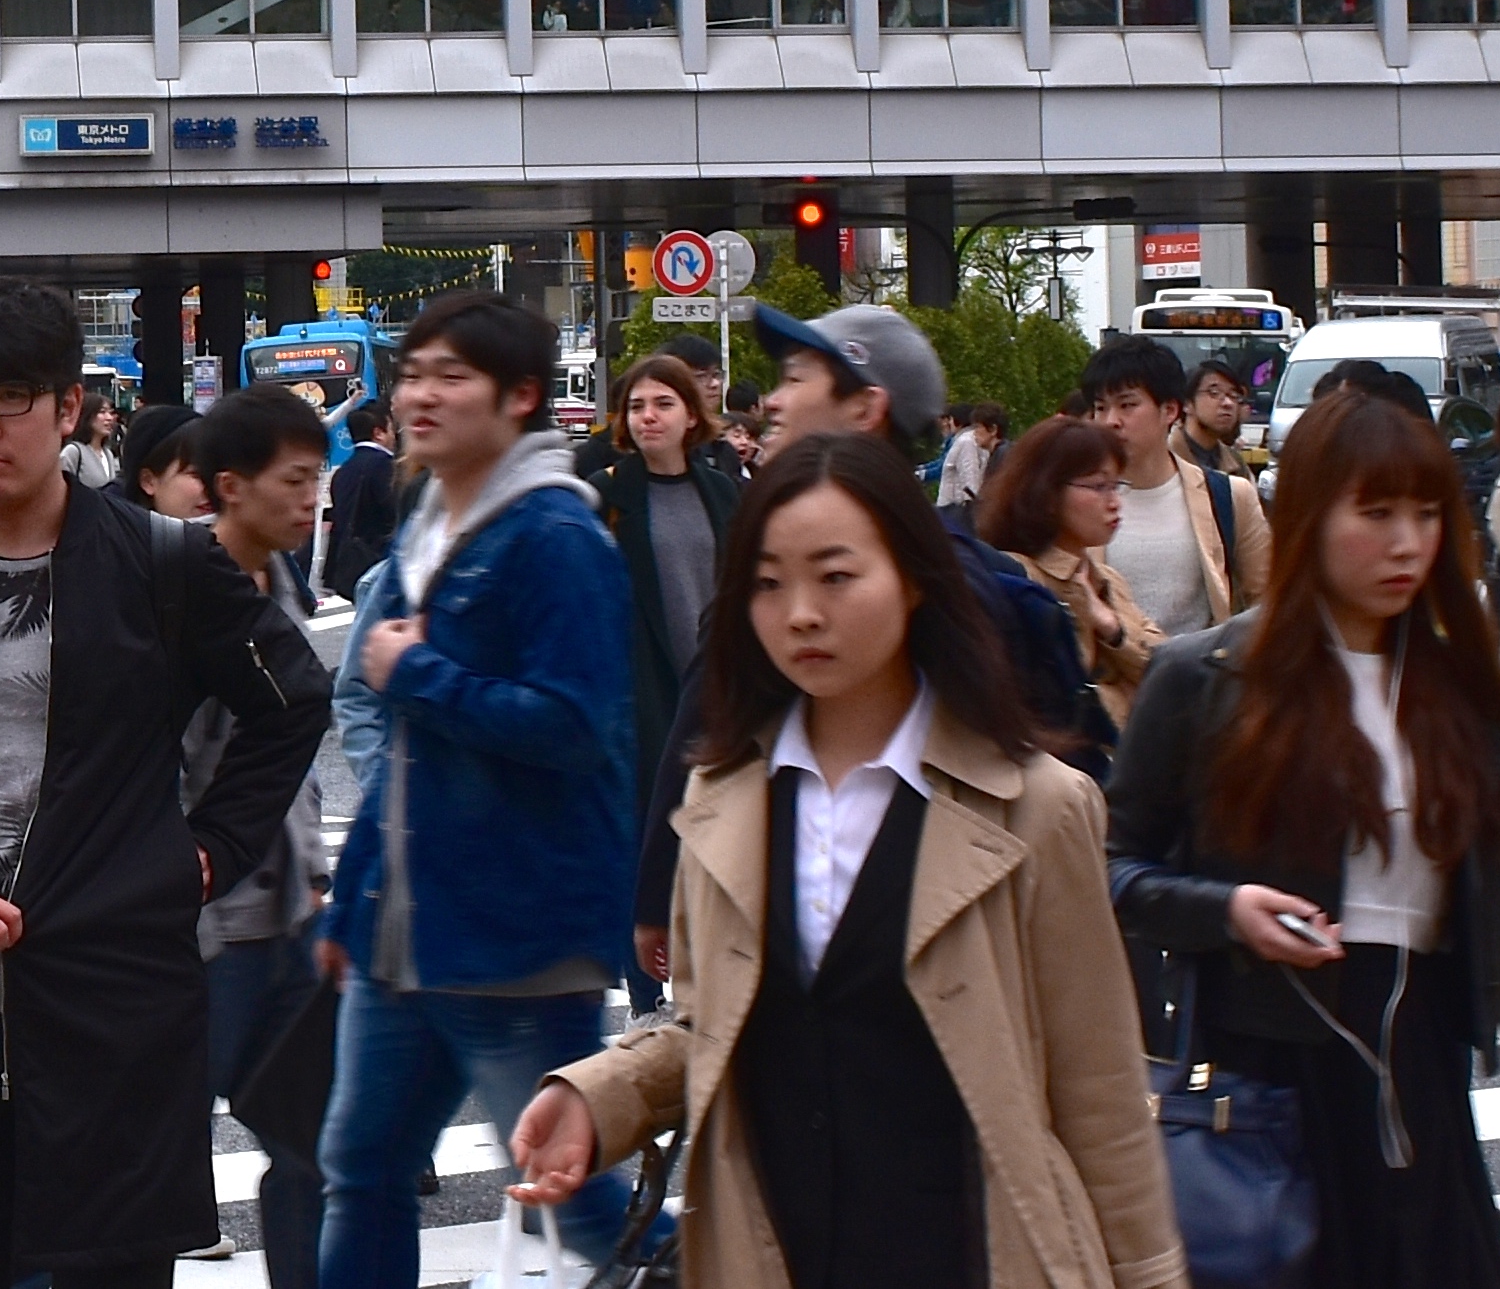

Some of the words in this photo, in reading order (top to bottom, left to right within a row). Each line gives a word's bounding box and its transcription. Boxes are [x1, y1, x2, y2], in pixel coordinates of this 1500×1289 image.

[77, 124, 129, 135] 東京メトロ
[80, 136, 102, 144] Tokyo
[104, 135, 126, 143] Metro
[658, 304, 710, 317] ここまで
